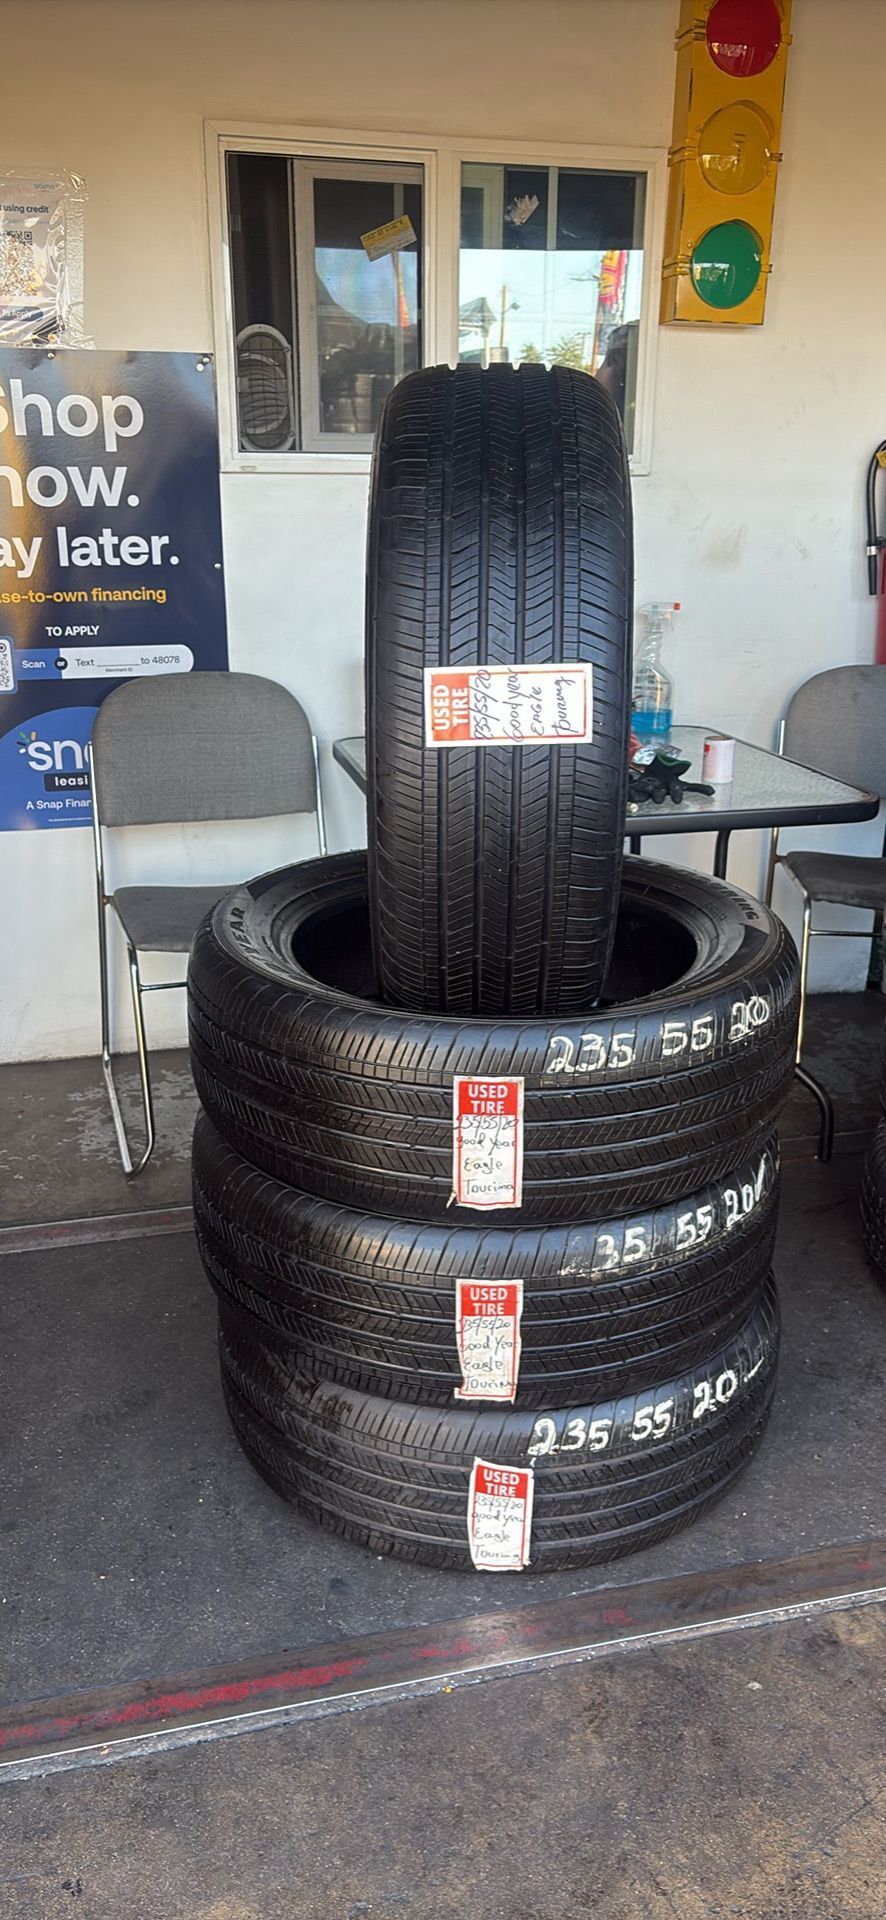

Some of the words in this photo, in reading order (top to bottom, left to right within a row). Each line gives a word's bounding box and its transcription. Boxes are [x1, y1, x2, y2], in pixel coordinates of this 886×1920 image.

[3, 204, 25, 213] using
[26, 205, 49, 213] credit
[0, 378, 145, 452] hop
[57, 526, 179, 567] later.
[91, 586, 167, 604] financing
[45, 626, 62, 637] TO
[65, 625, 100, 636] APPLY
[22, 659, 46, 669] Scan
[75, 658, 95, 667] Text
[140, 656, 150, 664] to
[151, 655, 181, 664] 48078
[433, 684, 450, 730] USED
[452, 687, 469, 727] TIRE
[26, 801, 35, 810] A
[36, 800, 63, 811] Snap
[547, 1028, 636, 1074] 235
[468, 1084, 508, 1098] USED
[471, 1100, 505, 1113] TIRE
[463, 1157, 503, 1174] Eagle
[676, 1204, 713, 1250] 55
[470, 1287, 508, 1300] USED
[472, 1303, 505, 1315] TIRE
[528, 1418, 613, 1457] 235
[630, 1398, 674, 1440] 55
[693, 1369, 738, 1419] 20
[482, 1469, 519, 1485] USED
[485, 1483, 516, 1496] TIRE
[475, 1544, 520, 1564] Touring
